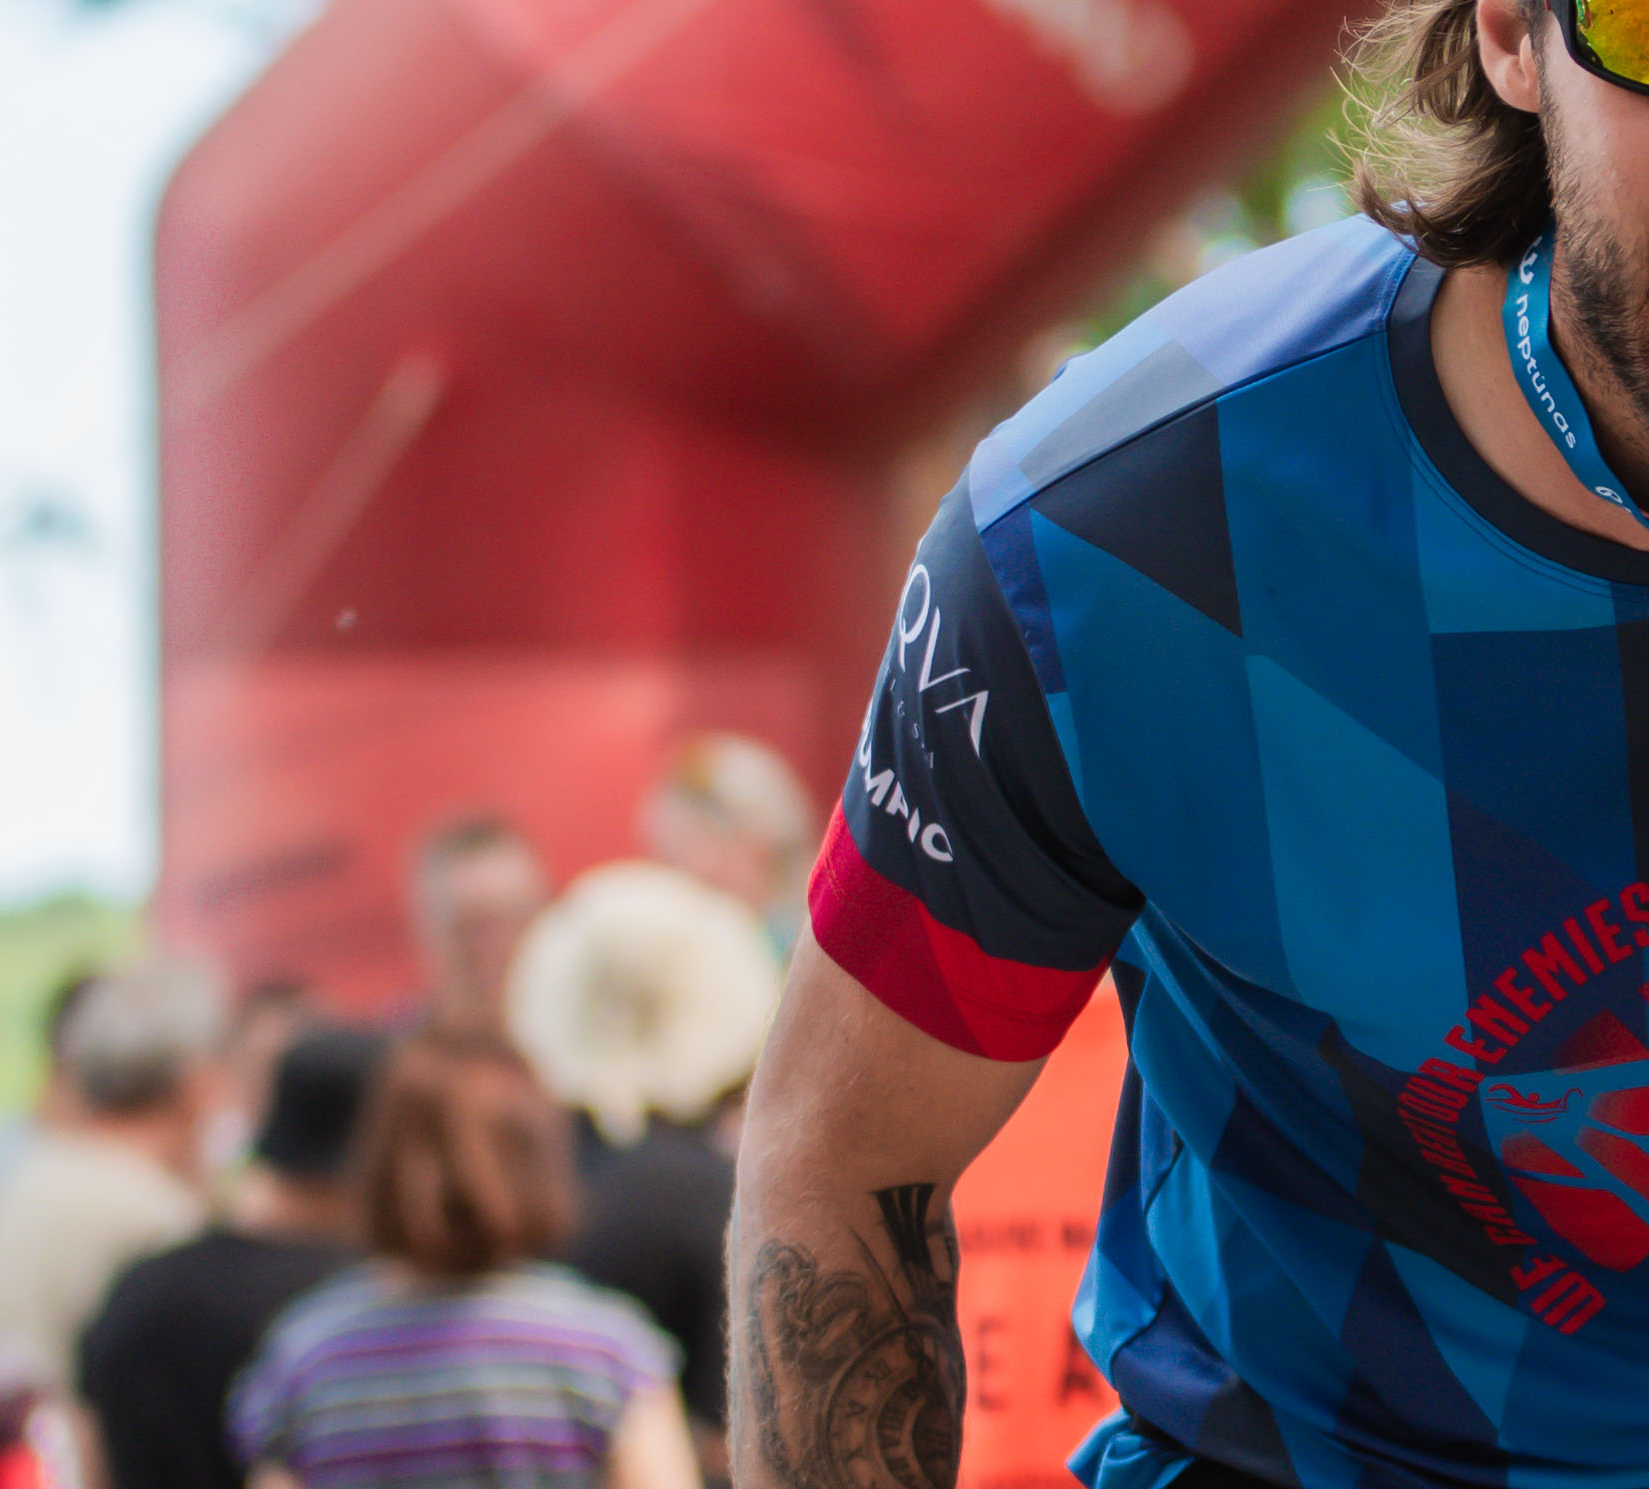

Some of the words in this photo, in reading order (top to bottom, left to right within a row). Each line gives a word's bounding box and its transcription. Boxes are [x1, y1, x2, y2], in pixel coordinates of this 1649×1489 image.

[1398, 1057, 1486, 1124] OUR
[1439, 1173, 1540, 1246] CAN
[1510, 1253, 1606, 1336] WE
